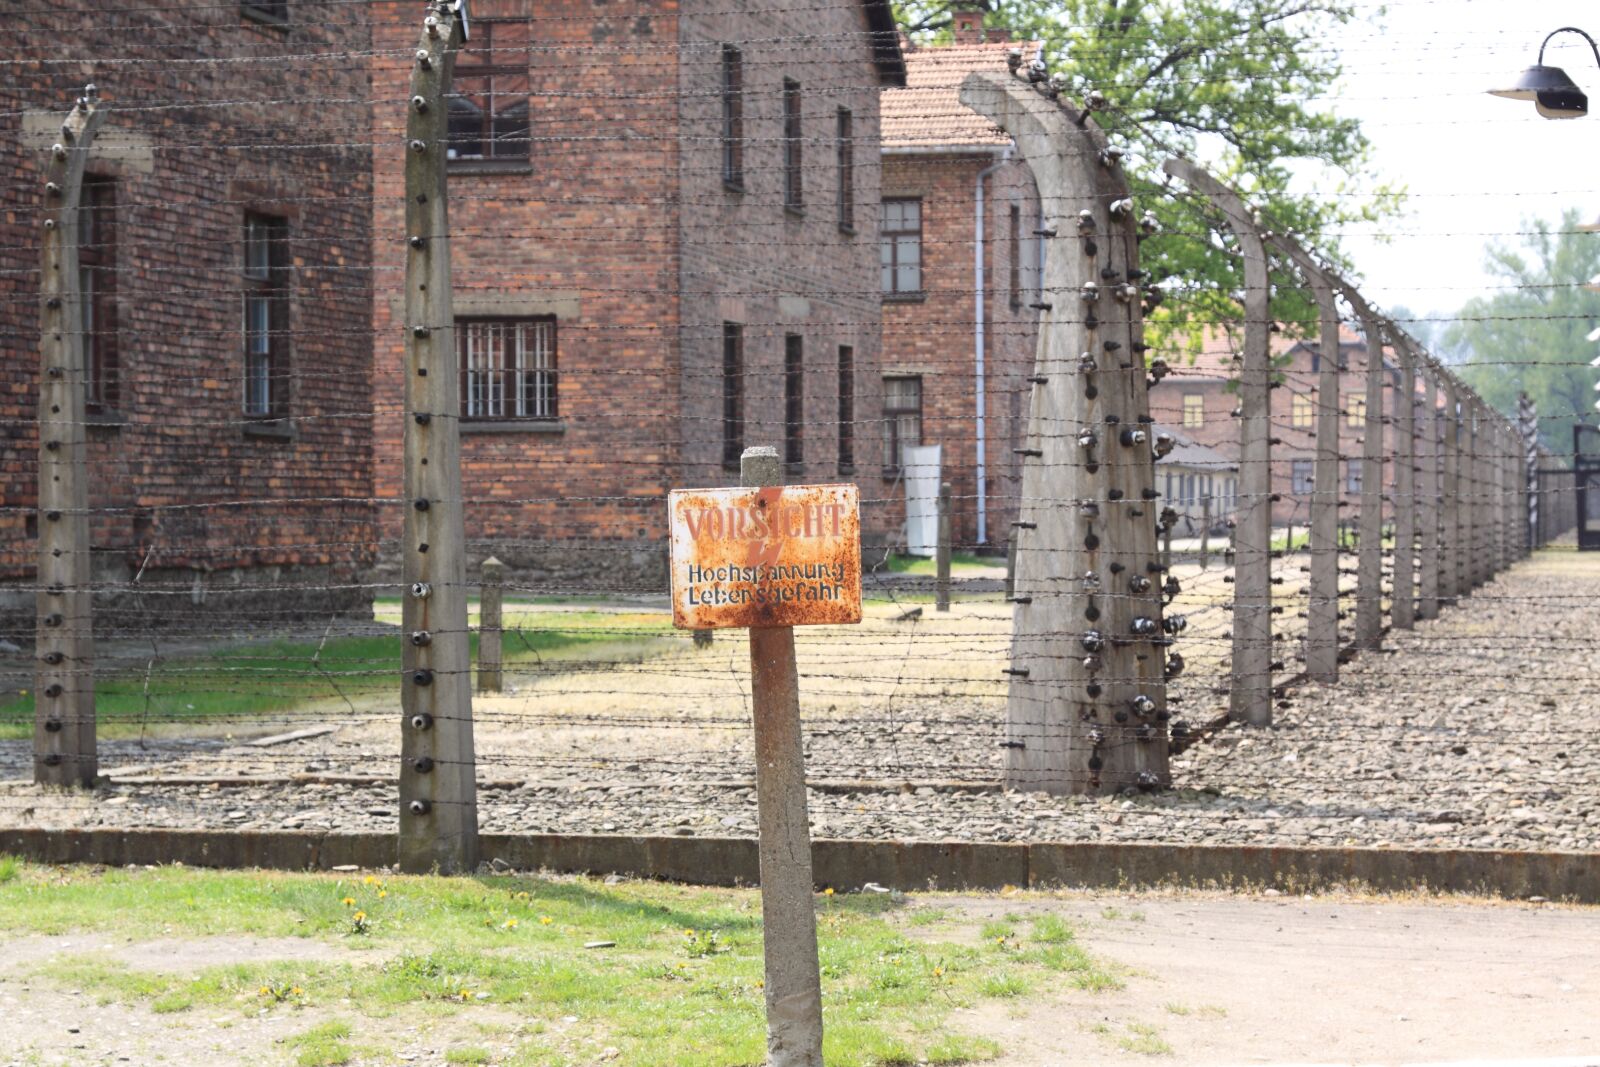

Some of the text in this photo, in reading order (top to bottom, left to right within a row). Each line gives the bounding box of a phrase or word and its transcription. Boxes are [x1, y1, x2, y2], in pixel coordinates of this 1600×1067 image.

[684, 503, 846, 541] VORSICHT
[688, 562, 845, 584] Hochspannung
[688, 582, 844, 606] Lebensgefahr
